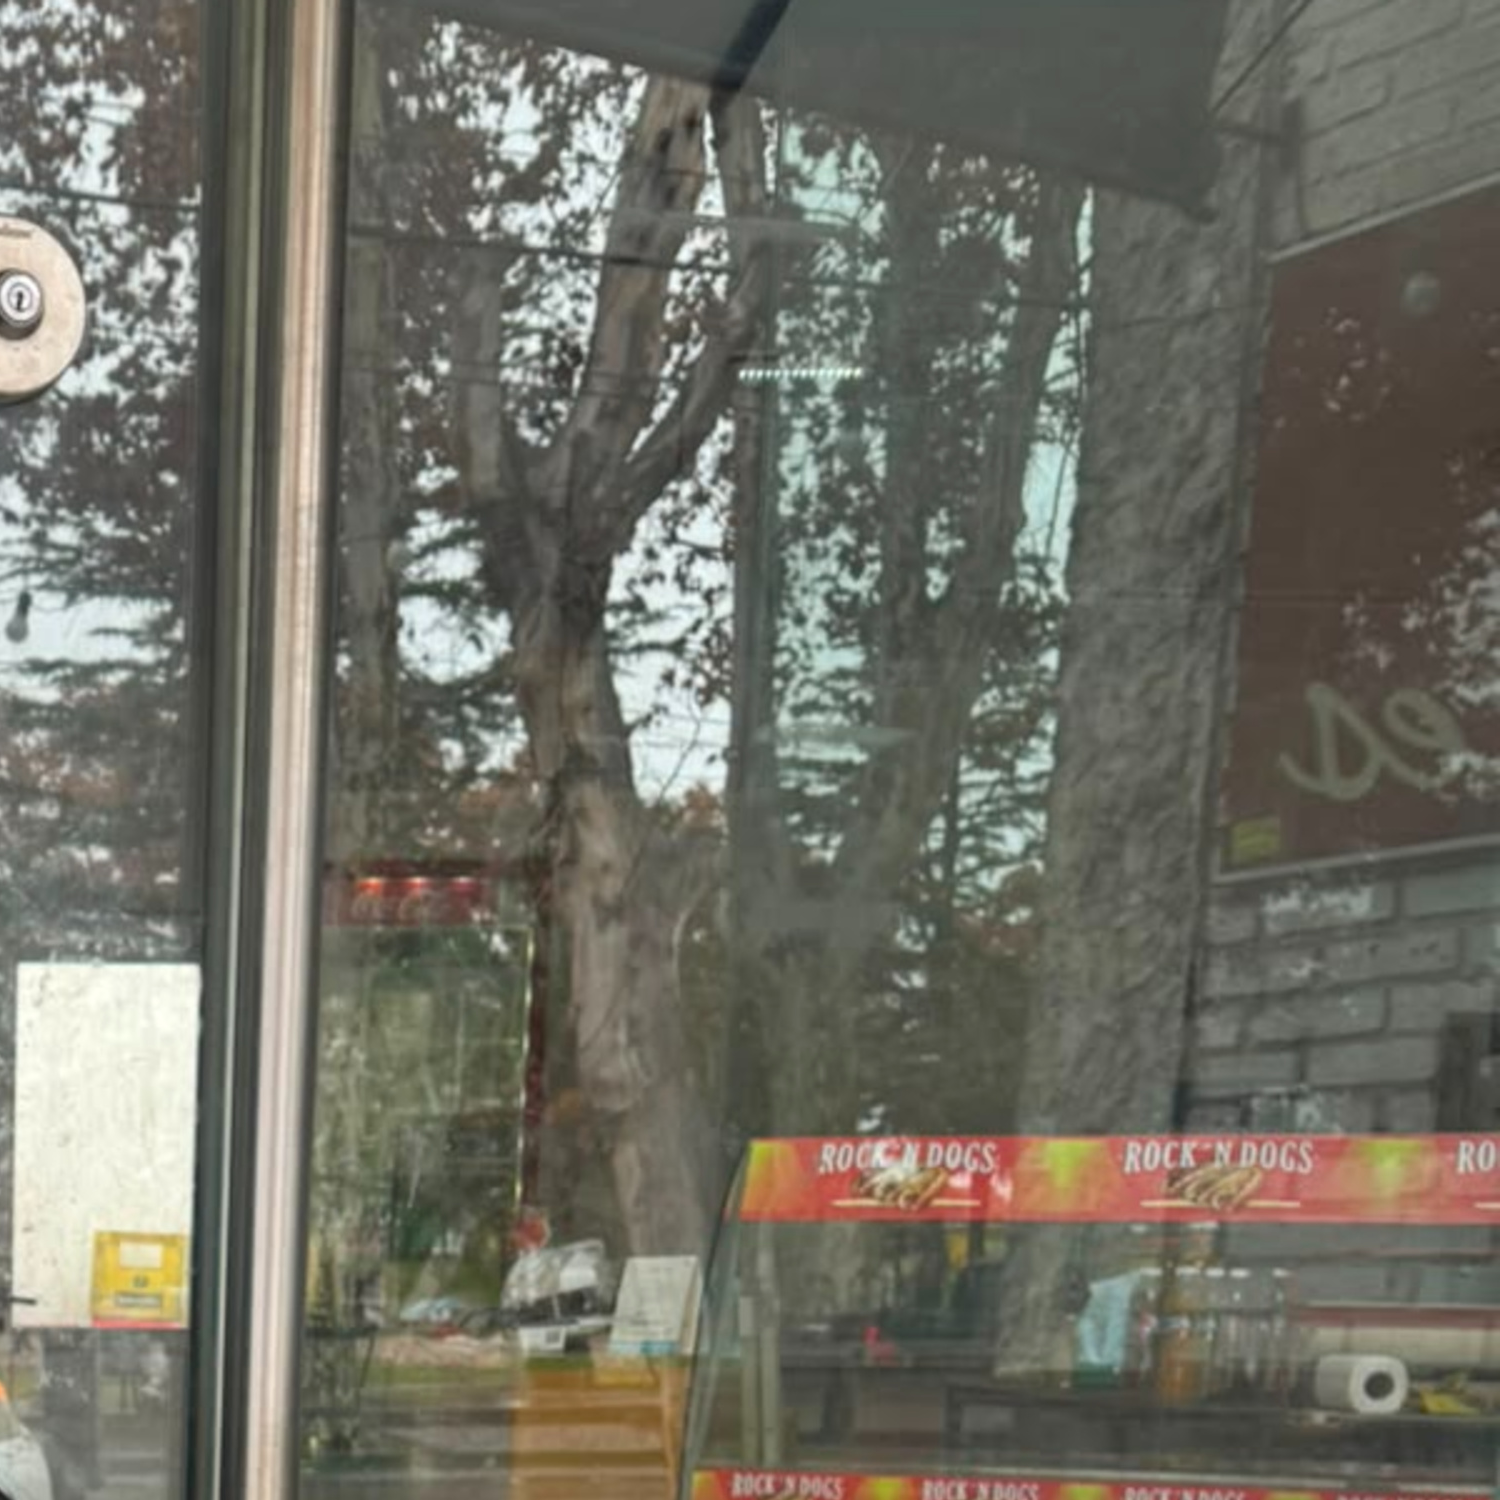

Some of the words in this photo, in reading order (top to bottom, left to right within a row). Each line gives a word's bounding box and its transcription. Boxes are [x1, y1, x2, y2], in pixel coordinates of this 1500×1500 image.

[819, 1141, 888, 1174] ROCK
[927, 1142, 996, 1173] DOGS
[1124, 1140, 1196, 1174] ROCK
[1239, 1140, 1314, 1174] DOGS
[731, 1472, 775, 1498] ROCK
